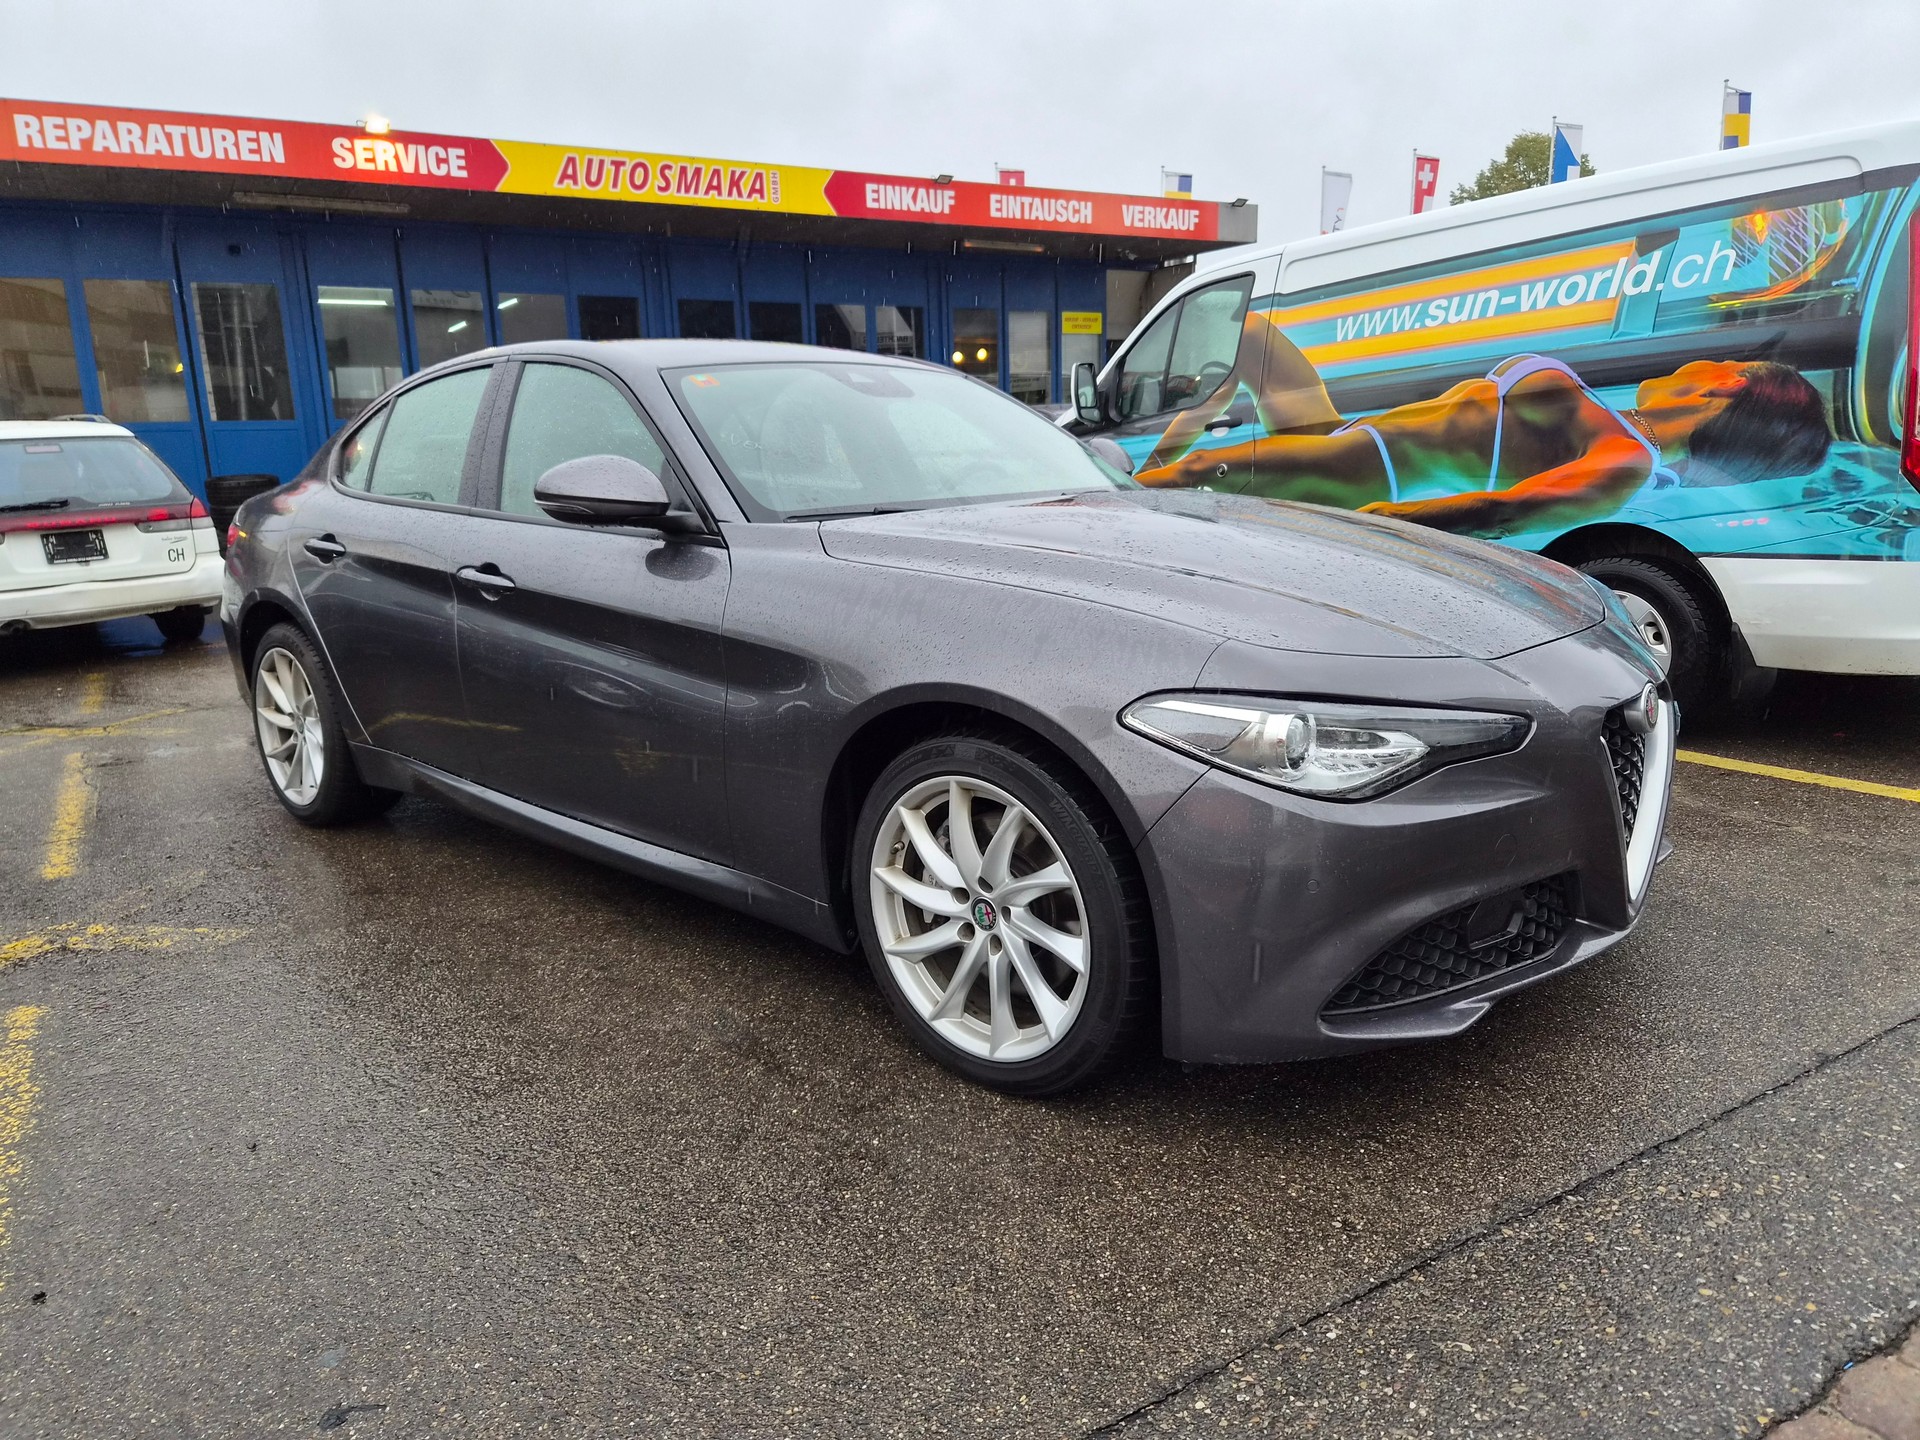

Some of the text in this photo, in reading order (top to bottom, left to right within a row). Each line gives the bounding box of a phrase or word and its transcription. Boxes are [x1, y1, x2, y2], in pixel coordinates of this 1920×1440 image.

[13, 114, 286, 164] REPARATUREN
[331, 136, 469, 178] SERVICE
[865, 183, 955, 214] EINKAUF
[989, 194, 1093, 225] EINTAUSCH
[1121, 204, 1200, 232] VERKAUF
[1336, 240, 1737, 343] www.sun-world.ch
[167, 547, 186, 563] CH
